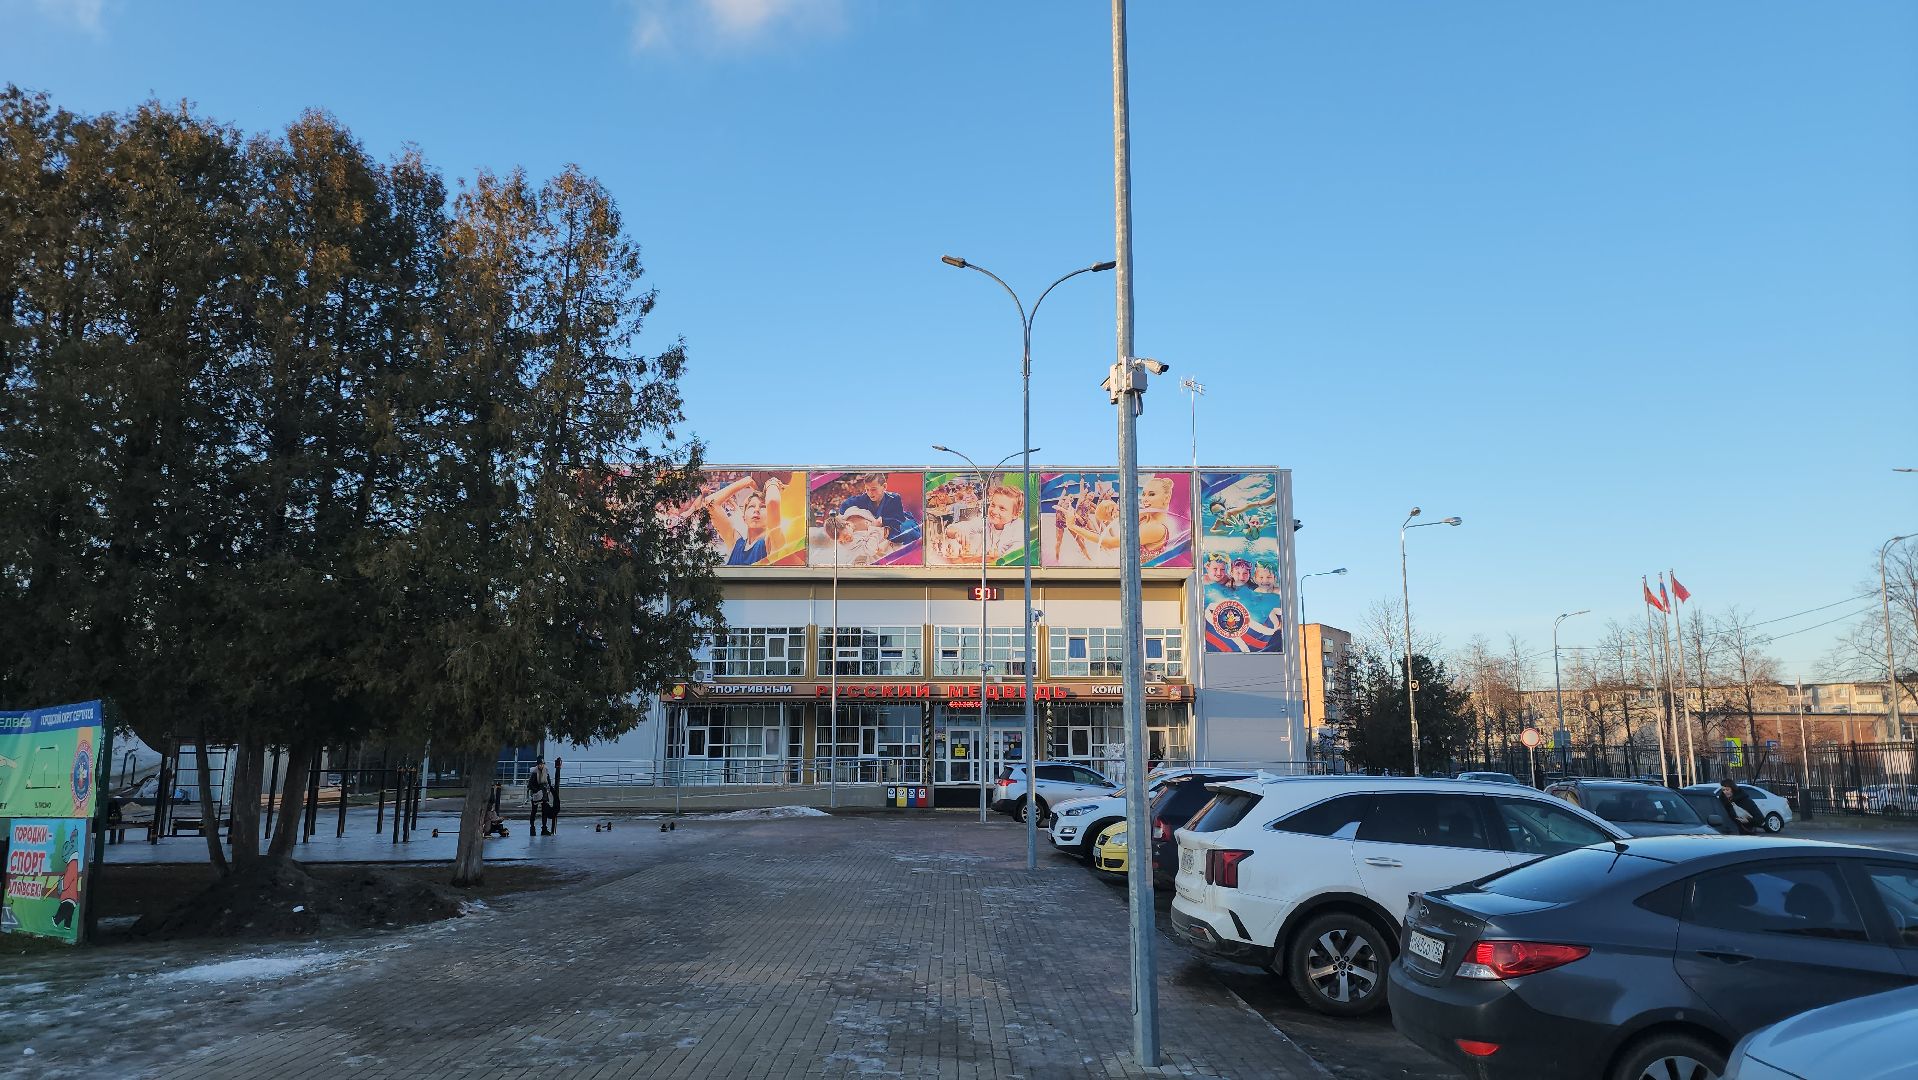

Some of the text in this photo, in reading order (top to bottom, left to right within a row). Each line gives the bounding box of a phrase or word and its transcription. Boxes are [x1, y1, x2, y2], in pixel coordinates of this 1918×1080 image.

[815, 683, 930, 698] РУССКИЙ
[1091, 685, 1156, 694] КОМПС
[14, 826, 47, 844] ГОРОДКИ
[10, 851, 45, 874] СПОРТ
